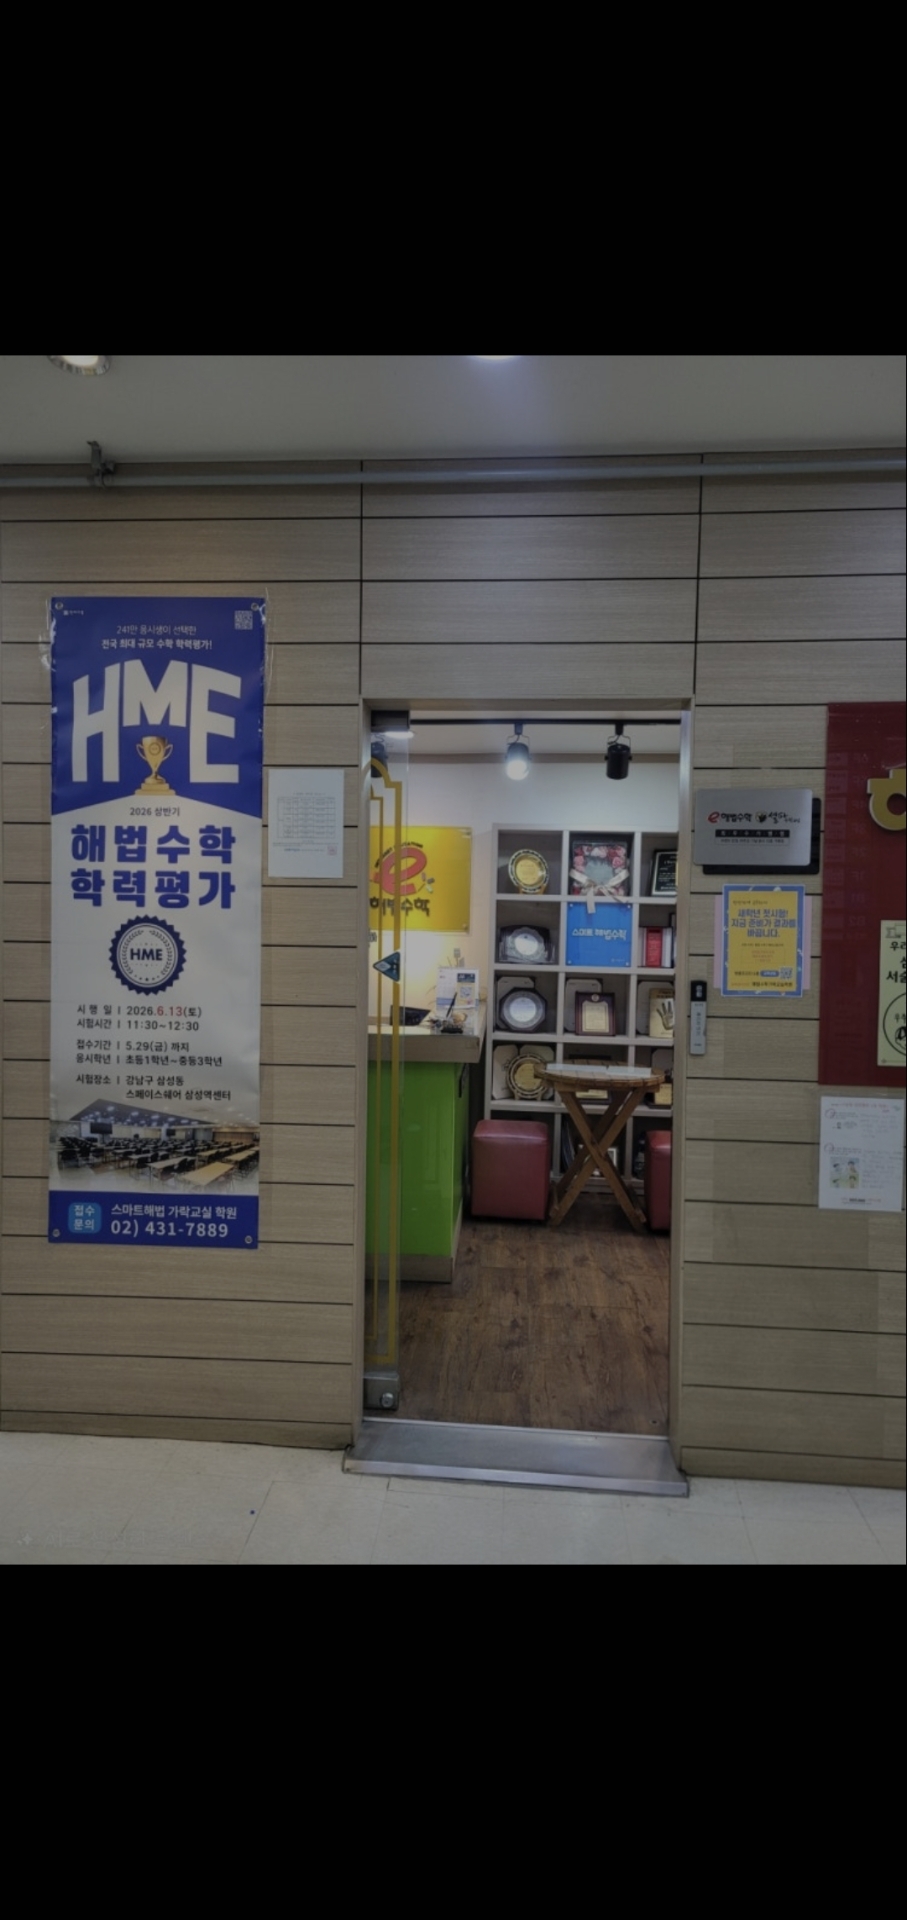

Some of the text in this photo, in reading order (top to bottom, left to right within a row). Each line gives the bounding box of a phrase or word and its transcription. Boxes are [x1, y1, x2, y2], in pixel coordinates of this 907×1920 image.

[116, 625, 197, 636] 241만 응시생이 선택한
[101, 639, 212, 651] 전국 최대 규모 수학 학력평가!
[72, 658, 242, 784] HME
[129, 807, 180, 817] 2026 상반기
[71, 824, 236, 864] 해법수학
[71, 868, 236, 909] 학력평가
[130, 948, 163, 961] HME
[126, 1006, 202, 1018] 2026.6.13(토)
[77, 1018, 200, 1031] 시험시간 11:30~12:30
[76, 1039, 190, 1053] 접수기간 5.29(금) 까지
[76, 1053, 223, 1067] 응시학년 초등1학년~중등3학년
[76, 1074, 185, 1087] 시험장소 강남구 삼성동
[126, 1089, 231, 1101] 스페이스쉐어 삼성역센터
[74, 1204, 95, 1217] 접수
[111, 1204, 238, 1220] 스마트해법 가락교실 학원
[74, 1219, 95, 1231] 문의
[111, 1220, 230, 1238] 02) 431-7889
